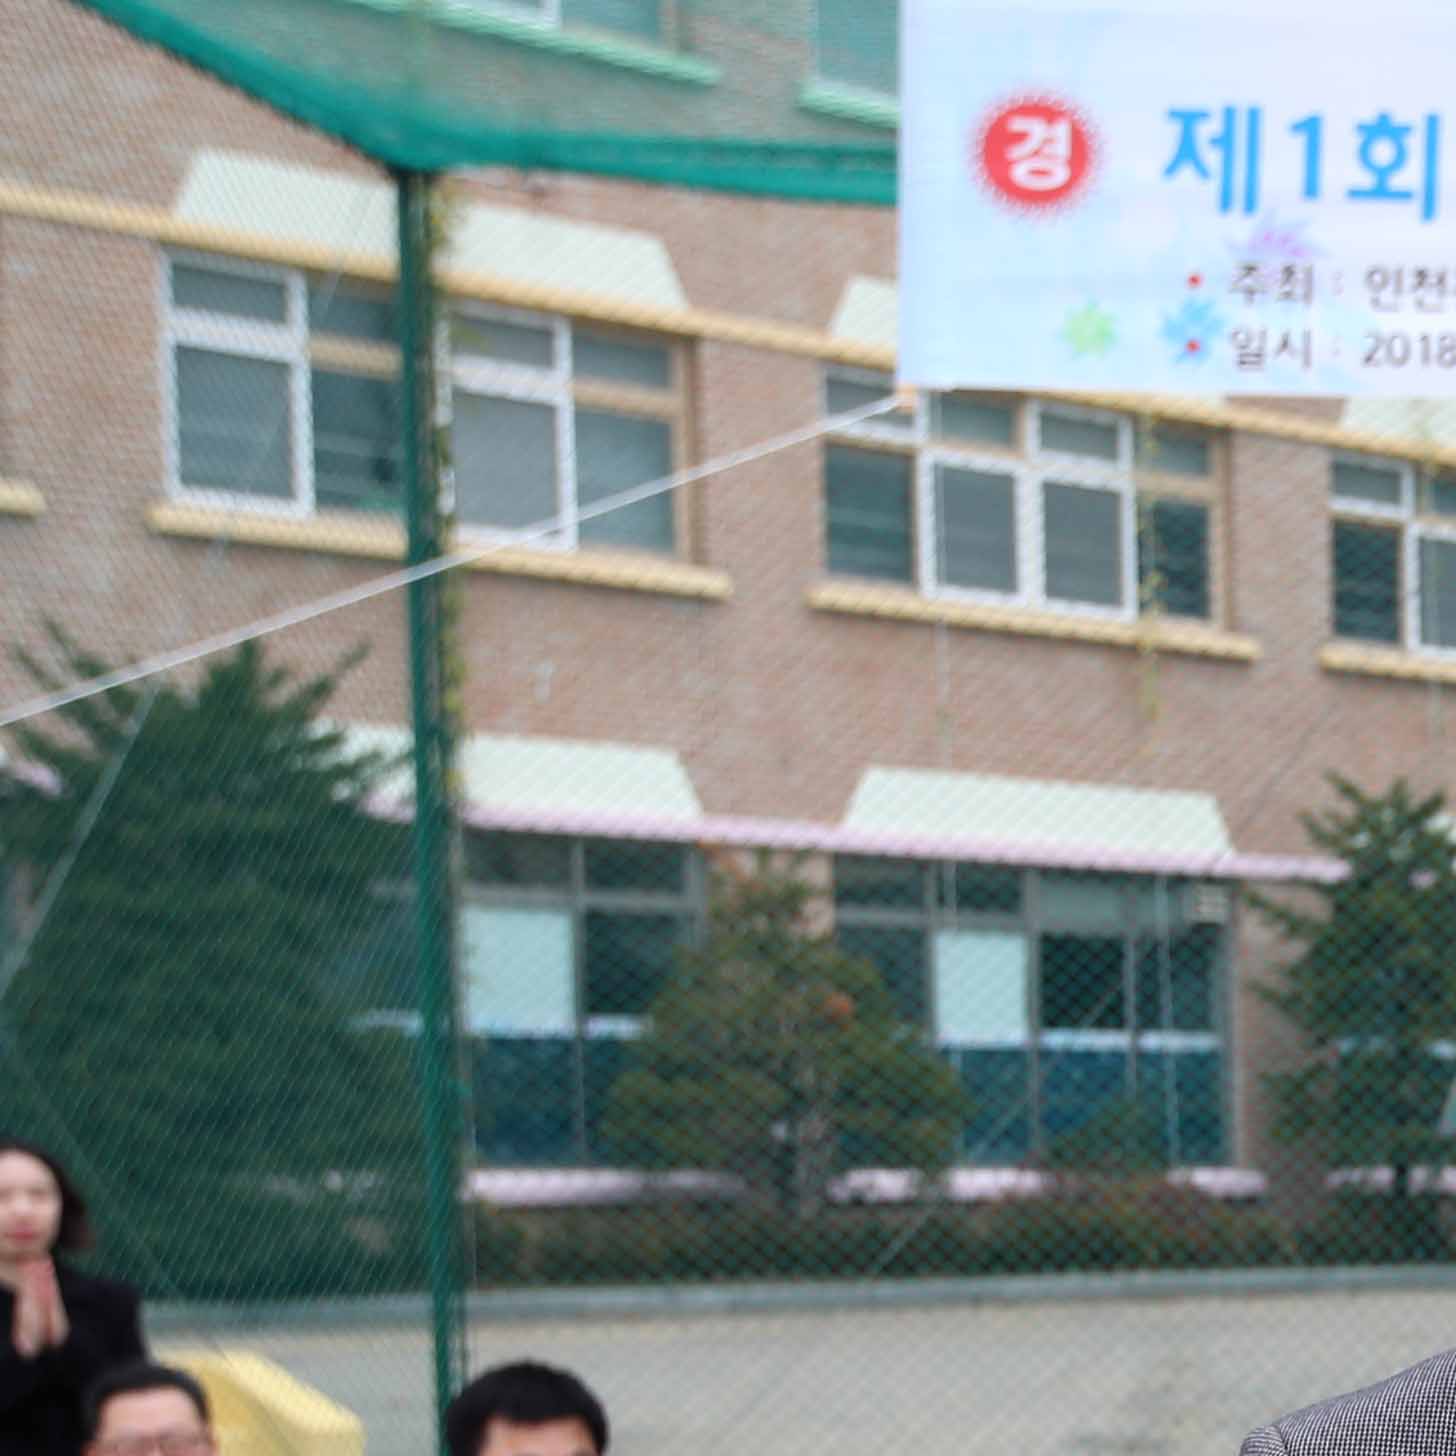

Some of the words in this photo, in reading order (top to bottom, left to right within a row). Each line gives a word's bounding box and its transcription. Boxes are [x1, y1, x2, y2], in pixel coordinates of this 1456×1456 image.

[1004, 114, 1075, 193] 경
[1161, 104, 1441, 223] 제1회
[1229, 263, 1315, 306] 주최
[1230, 328, 1313, 371] 일시
